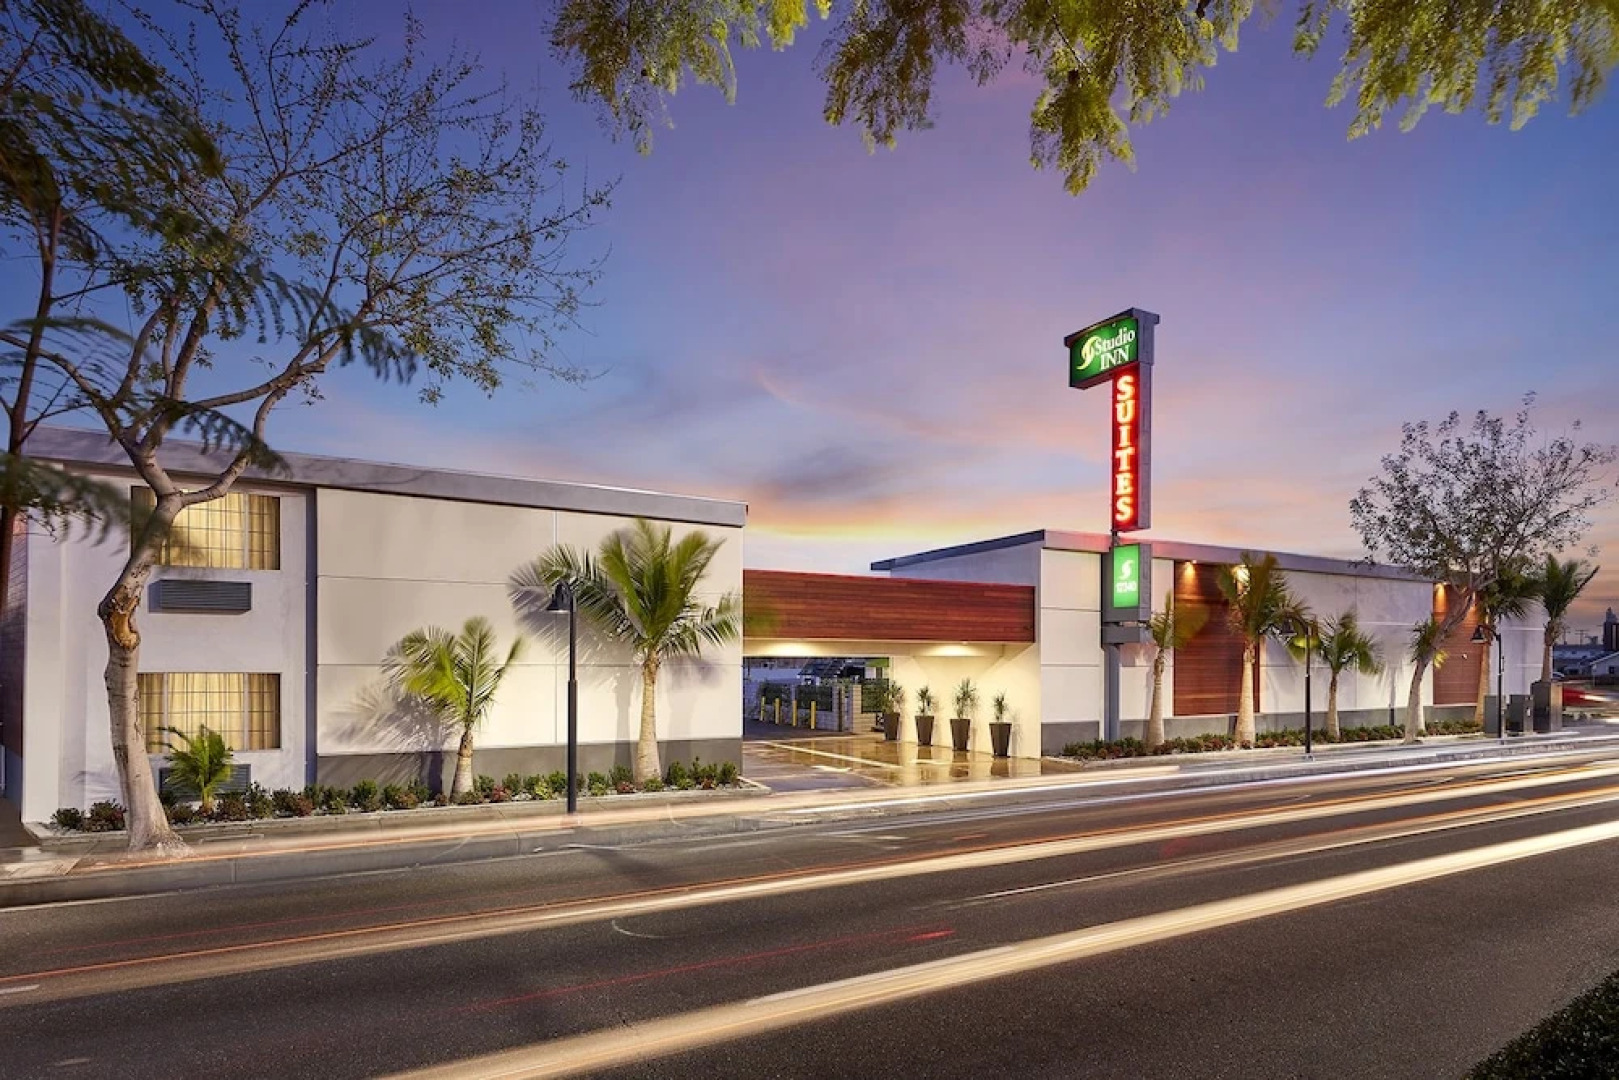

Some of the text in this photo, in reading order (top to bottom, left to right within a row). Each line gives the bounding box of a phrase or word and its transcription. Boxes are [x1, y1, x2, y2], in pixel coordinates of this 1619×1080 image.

[1095, 327, 1135, 354] Studio
[1100, 345, 1130, 370] INN
[1116, 375, 1135, 522] SUITES
